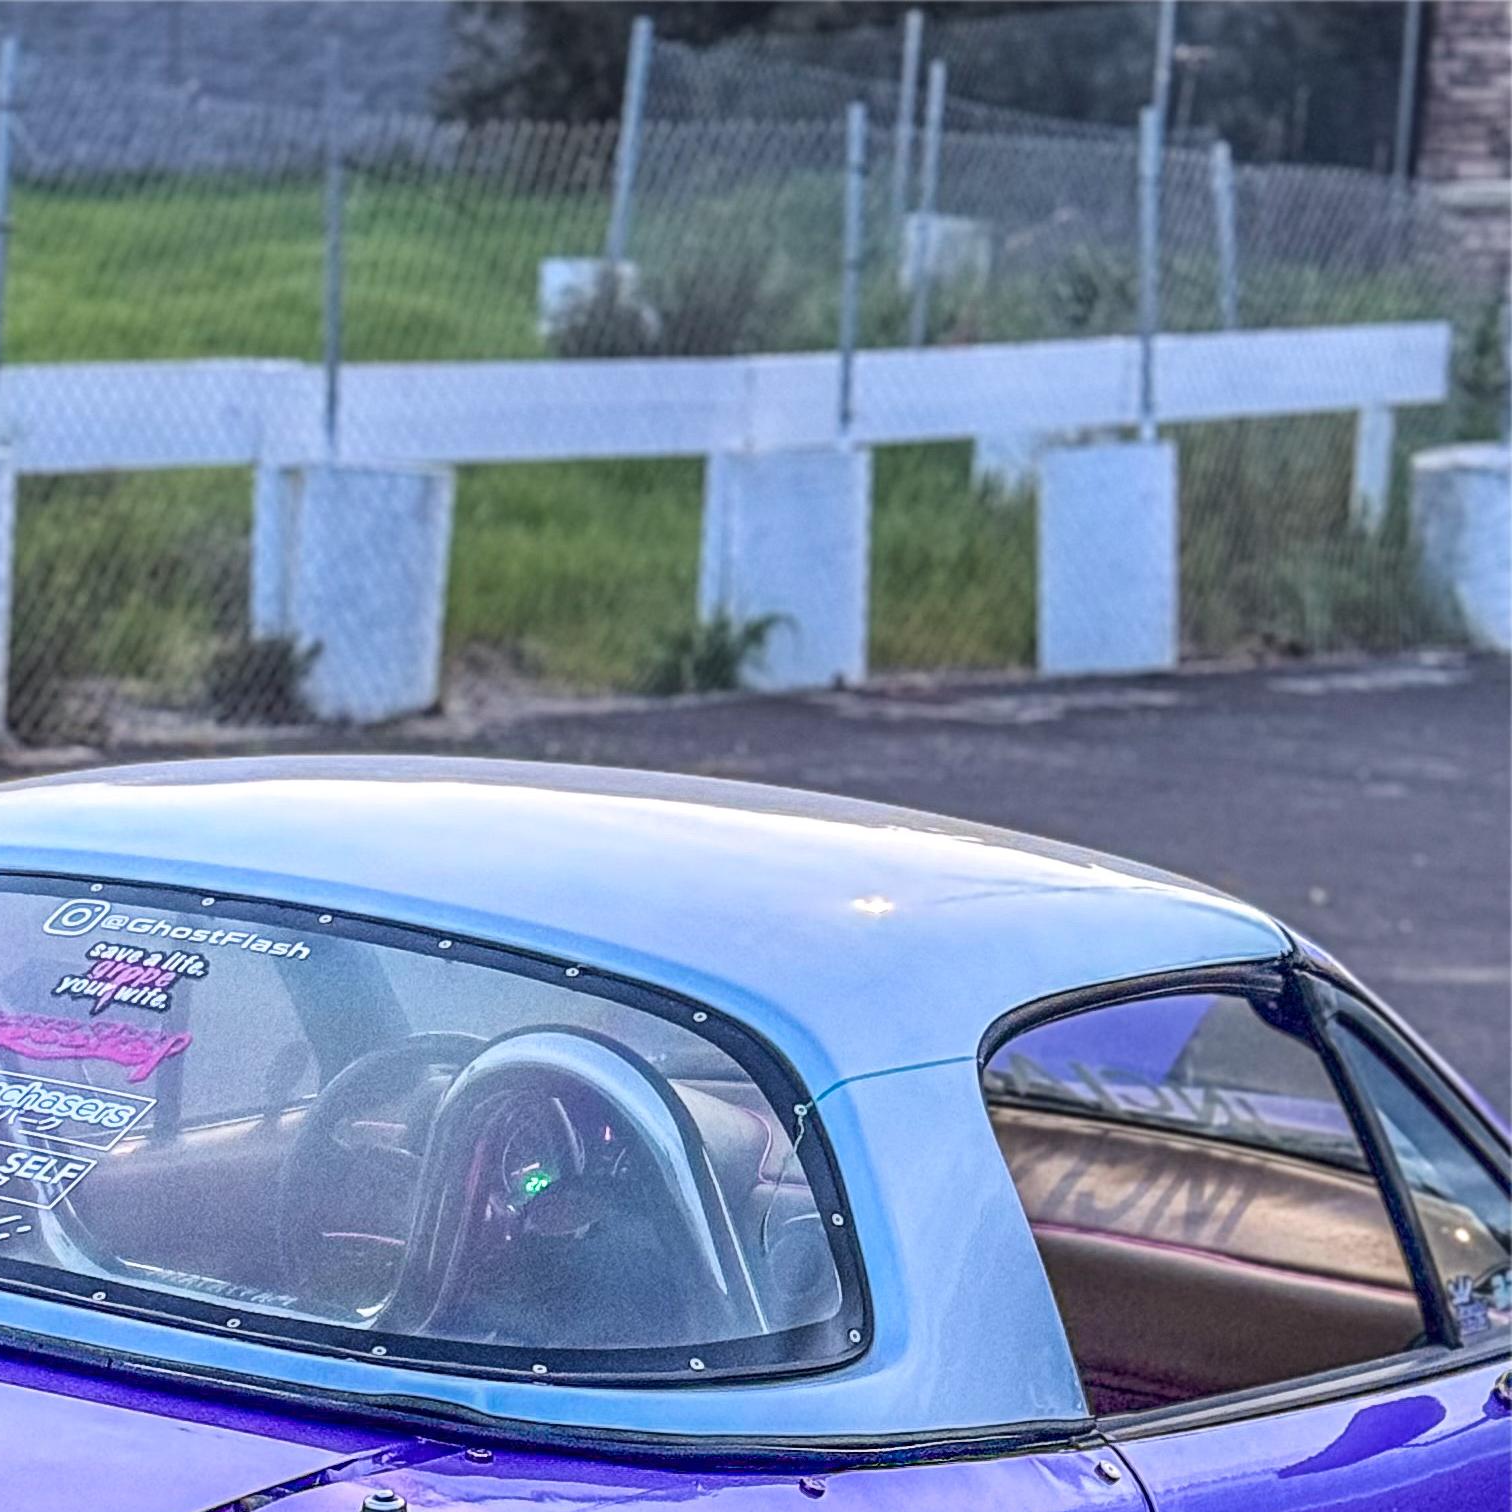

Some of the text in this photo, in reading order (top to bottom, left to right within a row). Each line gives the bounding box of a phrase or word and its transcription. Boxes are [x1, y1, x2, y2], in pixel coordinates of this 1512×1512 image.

[100, 914, 311, 960] @GhostFlash
[89, 943, 144, 964] save
[143, 953, 163, 967] a
[56, 976, 117, 997] your
[87, 960, 176, 998] grope
